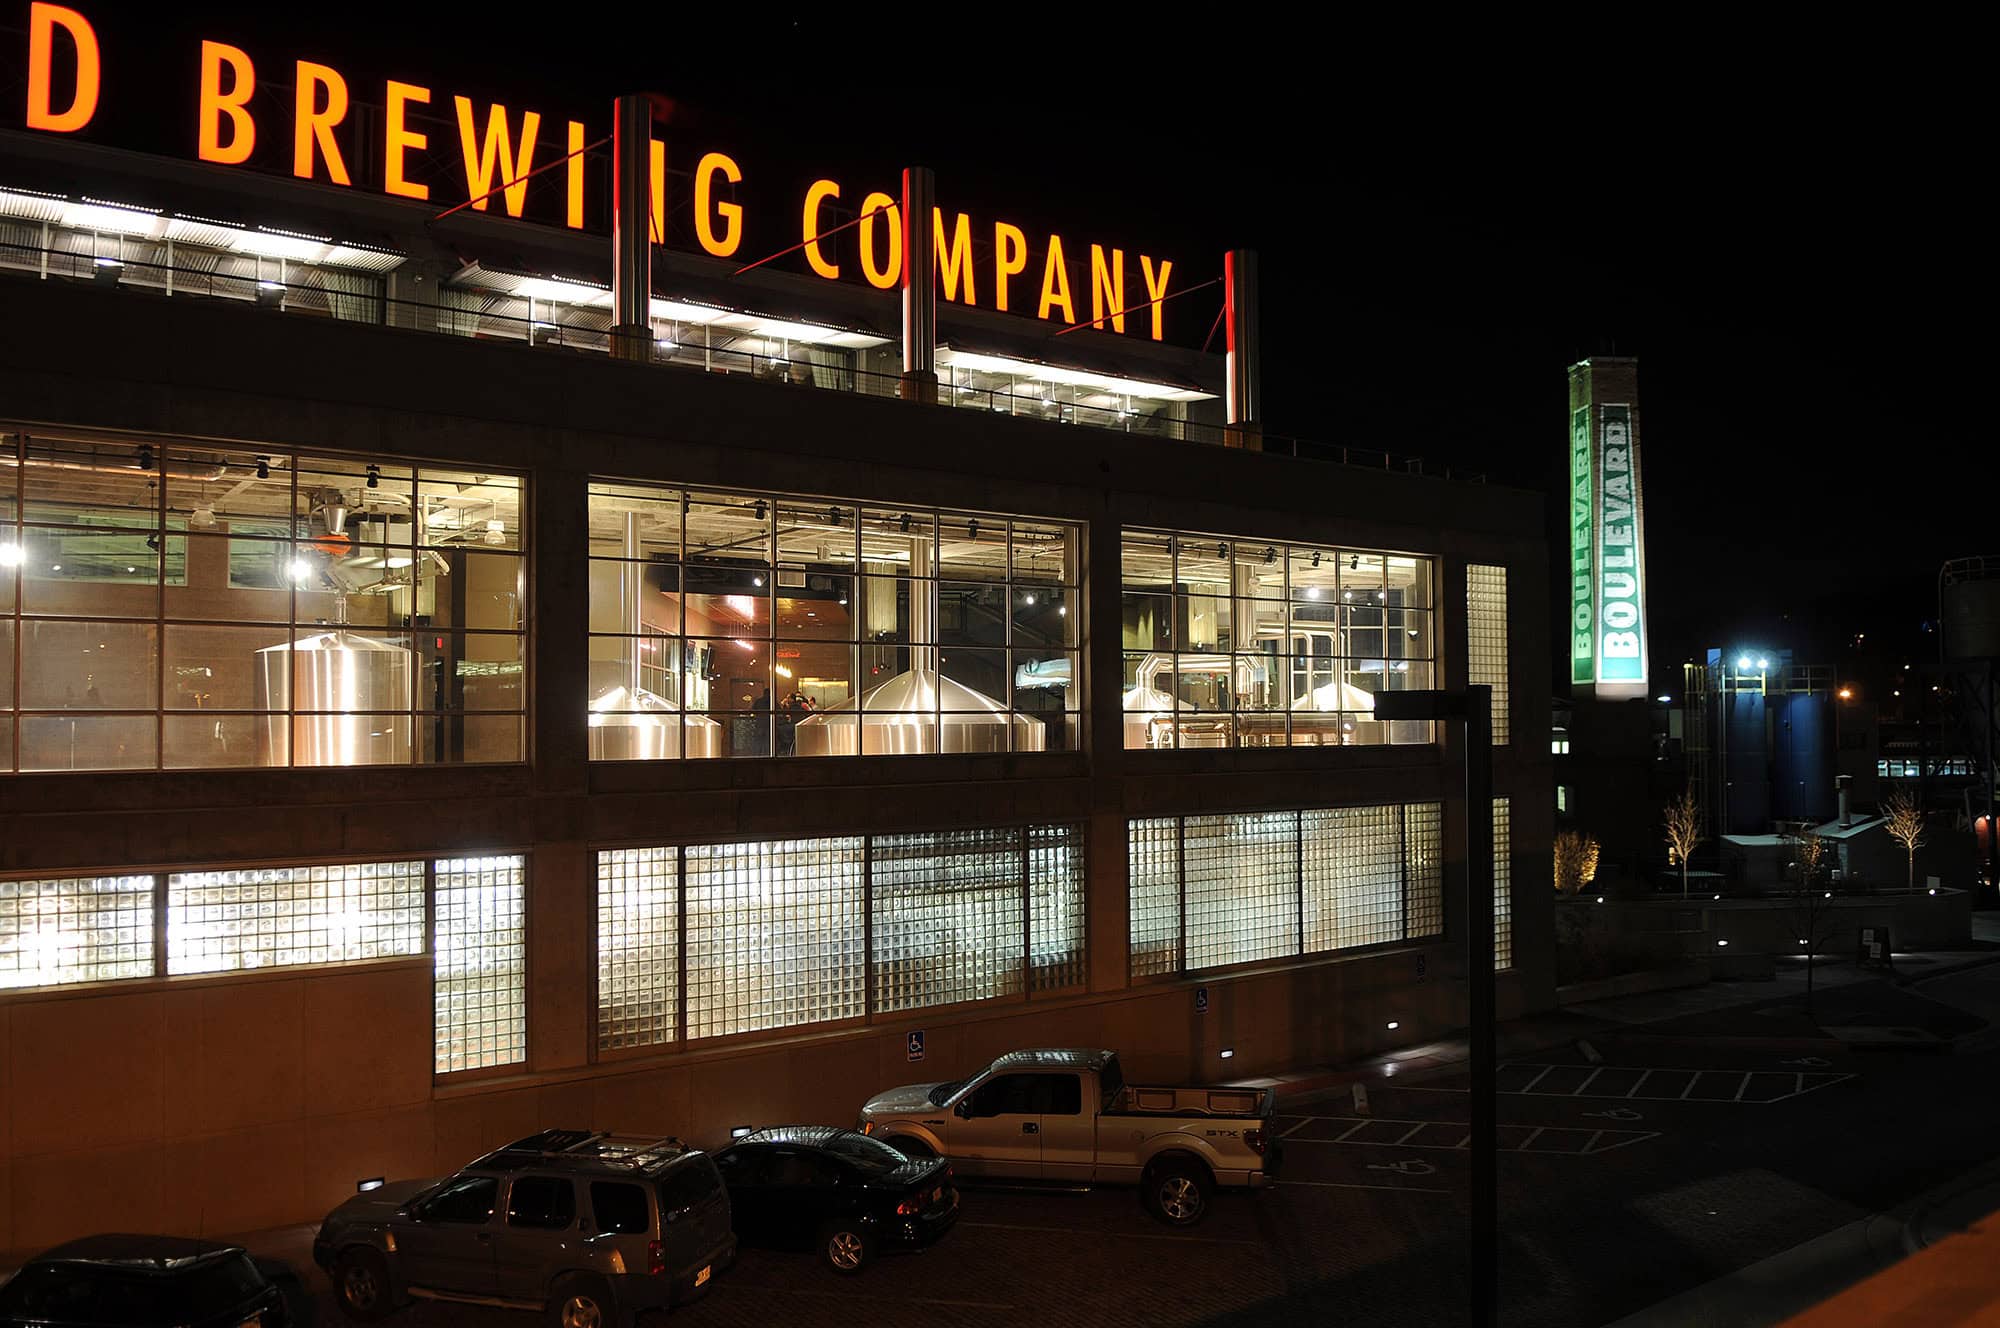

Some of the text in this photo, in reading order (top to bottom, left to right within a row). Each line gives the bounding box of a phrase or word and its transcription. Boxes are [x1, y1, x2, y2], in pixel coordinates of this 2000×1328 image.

[803, 179, 1172, 341] COMPANY
[1574, 425, 1592, 660] BOULEVARD
[1603, 420, 1640, 658] BOULEVARD
[1206, 1129, 1238, 1137] STX
